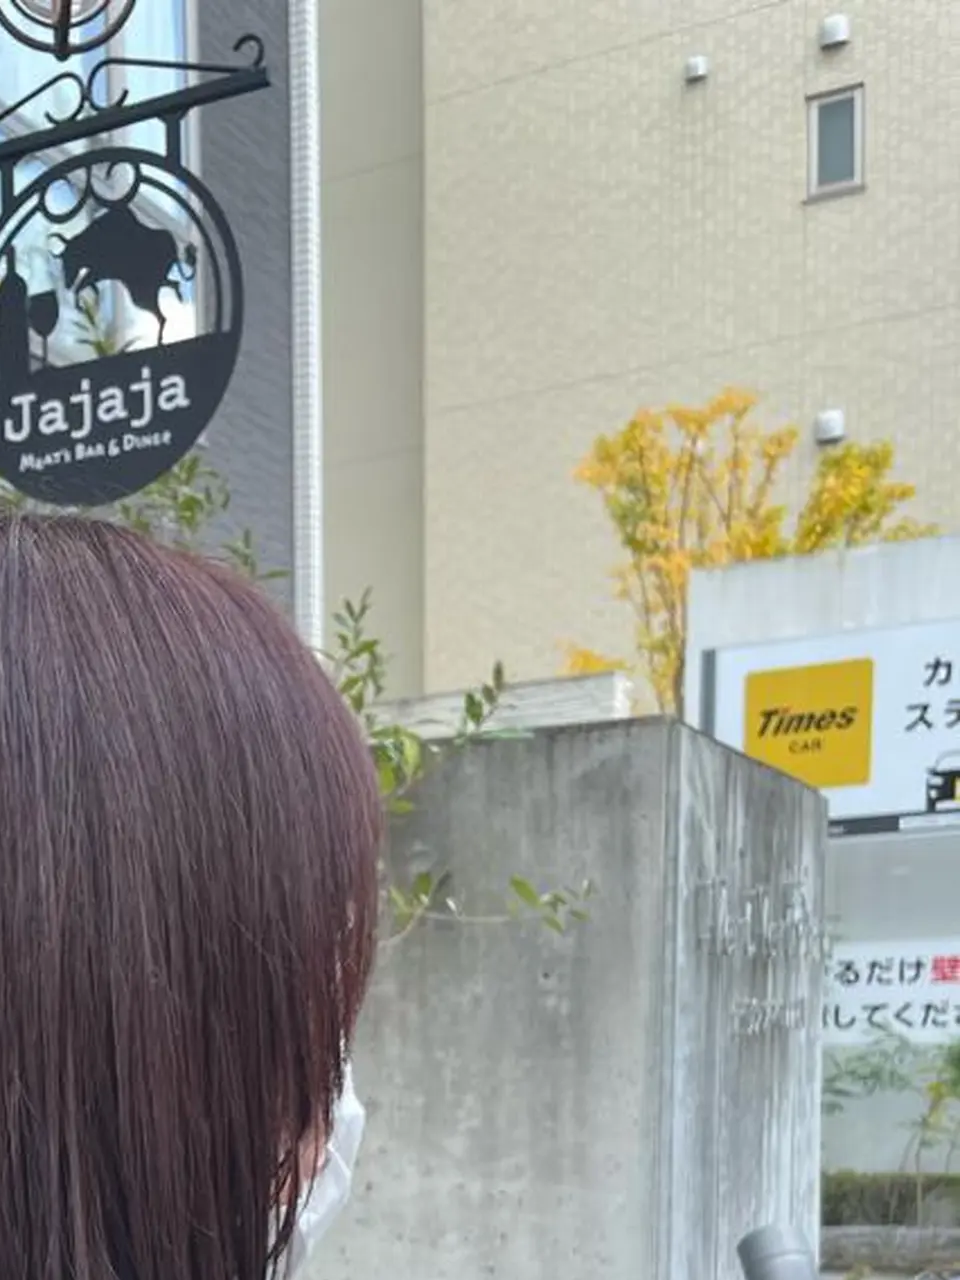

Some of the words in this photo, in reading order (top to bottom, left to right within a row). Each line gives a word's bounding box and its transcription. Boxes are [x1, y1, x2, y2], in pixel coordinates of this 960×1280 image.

[3, 366, 191, 444] Jajaja
[756, 704, 859, 740] Times
[787, 737, 823, 755] CAR
